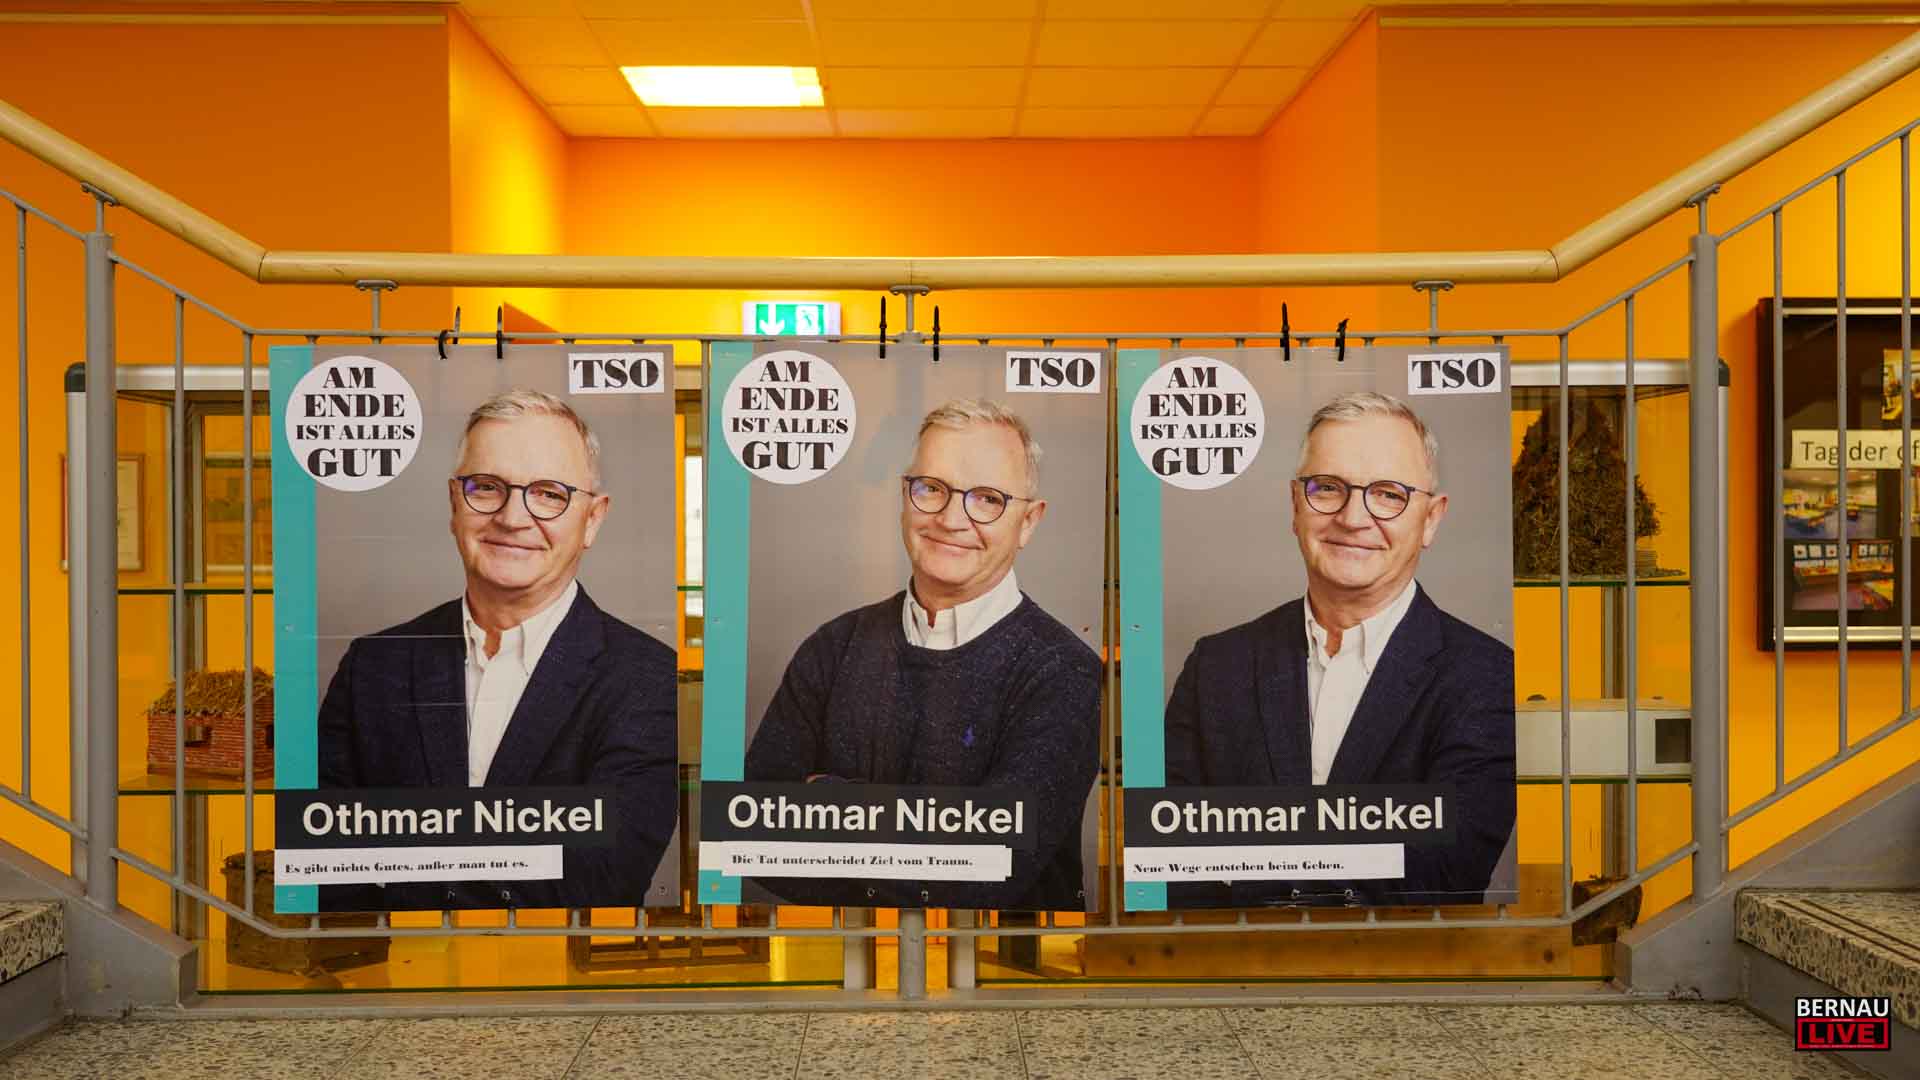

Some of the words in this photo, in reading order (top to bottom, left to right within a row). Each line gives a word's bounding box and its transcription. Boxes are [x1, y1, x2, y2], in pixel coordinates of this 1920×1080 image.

[322, 367, 377, 389] AM
[573, 358, 660, 389] TSO
[759, 360, 811, 383] AM
[1010, 357, 1096, 388] TSO
[1167, 366, 1218, 389] AM
[1411, 358, 1497, 389] TSO
[303, 394, 405, 418] ENDE
[740, 387, 840, 412] ENDE
[1148, 393, 1247, 418] ENDE
[296, 424, 335, 440] IST
[339, 424, 416, 440] ALLES
[731, 417, 770, 433] IST
[774, 418, 849, 434] ALLES
[1140, 423, 1179, 440] IST
[1181, 423, 1257, 440] ALLES
[307, 447, 401, 478] GUT
[742, 440, 834, 470] GUT
[1151, 446, 1243, 476] GUT
[1801, 441, 1839, 465] Tag
[1849, 440, 1888, 461] der
[303, 802, 463, 836] Othmar
[473, 798, 604, 834] Nickel
[728, 794, 886, 831] Othmar
[896, 797, 1025, 835] Nickel
[1150, 800, 1307, 834] Othmar
[1317, 796, 1444, 832] Nickel
[285, 863, 301, 874] Es
[304, 862, 329, 875] gibt
[332, 862, 371, 874] nichts
[417, 859, 455, 871] außer
[459, 860, 486, 870] man
[490, 859, 509, 869] tut
[512, 859, 529, 869] es.
[731, 854, 753, 865] Die
[757, 854, 778, 865] Tat
[782, 855, 867, 866] unterscheidet
[869, 855, 894, 866] Ziel
[898, 857, 923, 866] vom
[926, 856, 974, 867] Traum.
[1134, 863, 1165, 873] Neue
[1168, 862, 1202, 874] Wege
[1205, 862, 1265, 872] entstehen
[1268, 861, 1299, 871] beim
[1302, 860, 1345, 871] Gehen.
